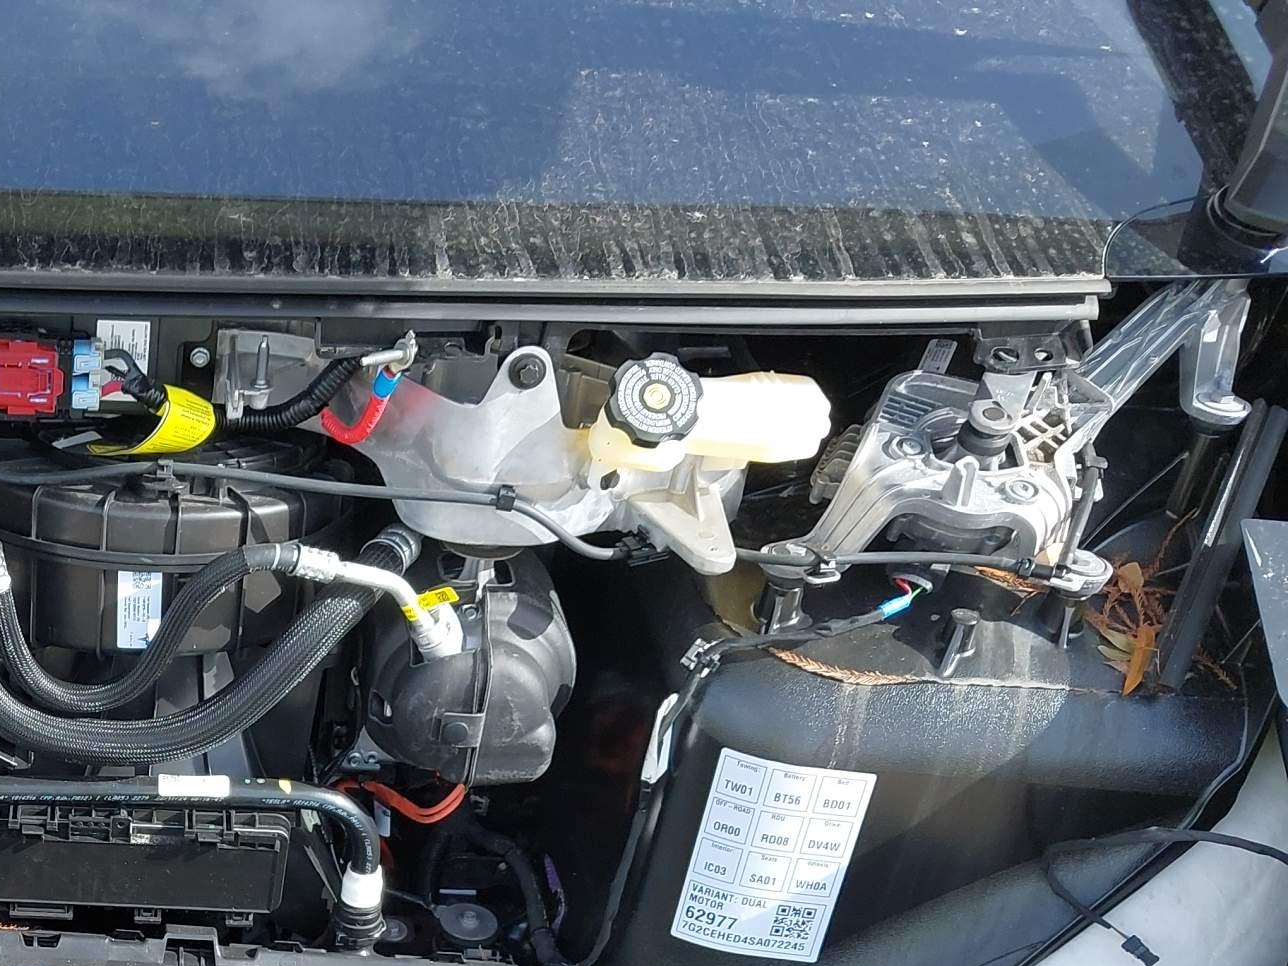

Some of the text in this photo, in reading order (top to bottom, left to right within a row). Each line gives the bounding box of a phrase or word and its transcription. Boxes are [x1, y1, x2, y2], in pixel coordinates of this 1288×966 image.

[724, 779, 754, 796] TW01
[773, 793, 801, 806] BT56
[823, 799, 851, 811] BD01
[761, 834, 790, 846] RD08
[808, 840, 841, 852] DV4W
[704, 861, 727, 876] IC03
[749, 873, 777, 886] SA01
[688, 893, 724, 911] MOTOR
[691, 882, 769, 909] VARIANT: DUAL
[685, 905, 739, 930] 62977
[682, 920, 806, 951] 7G2CEHED4SA072245
